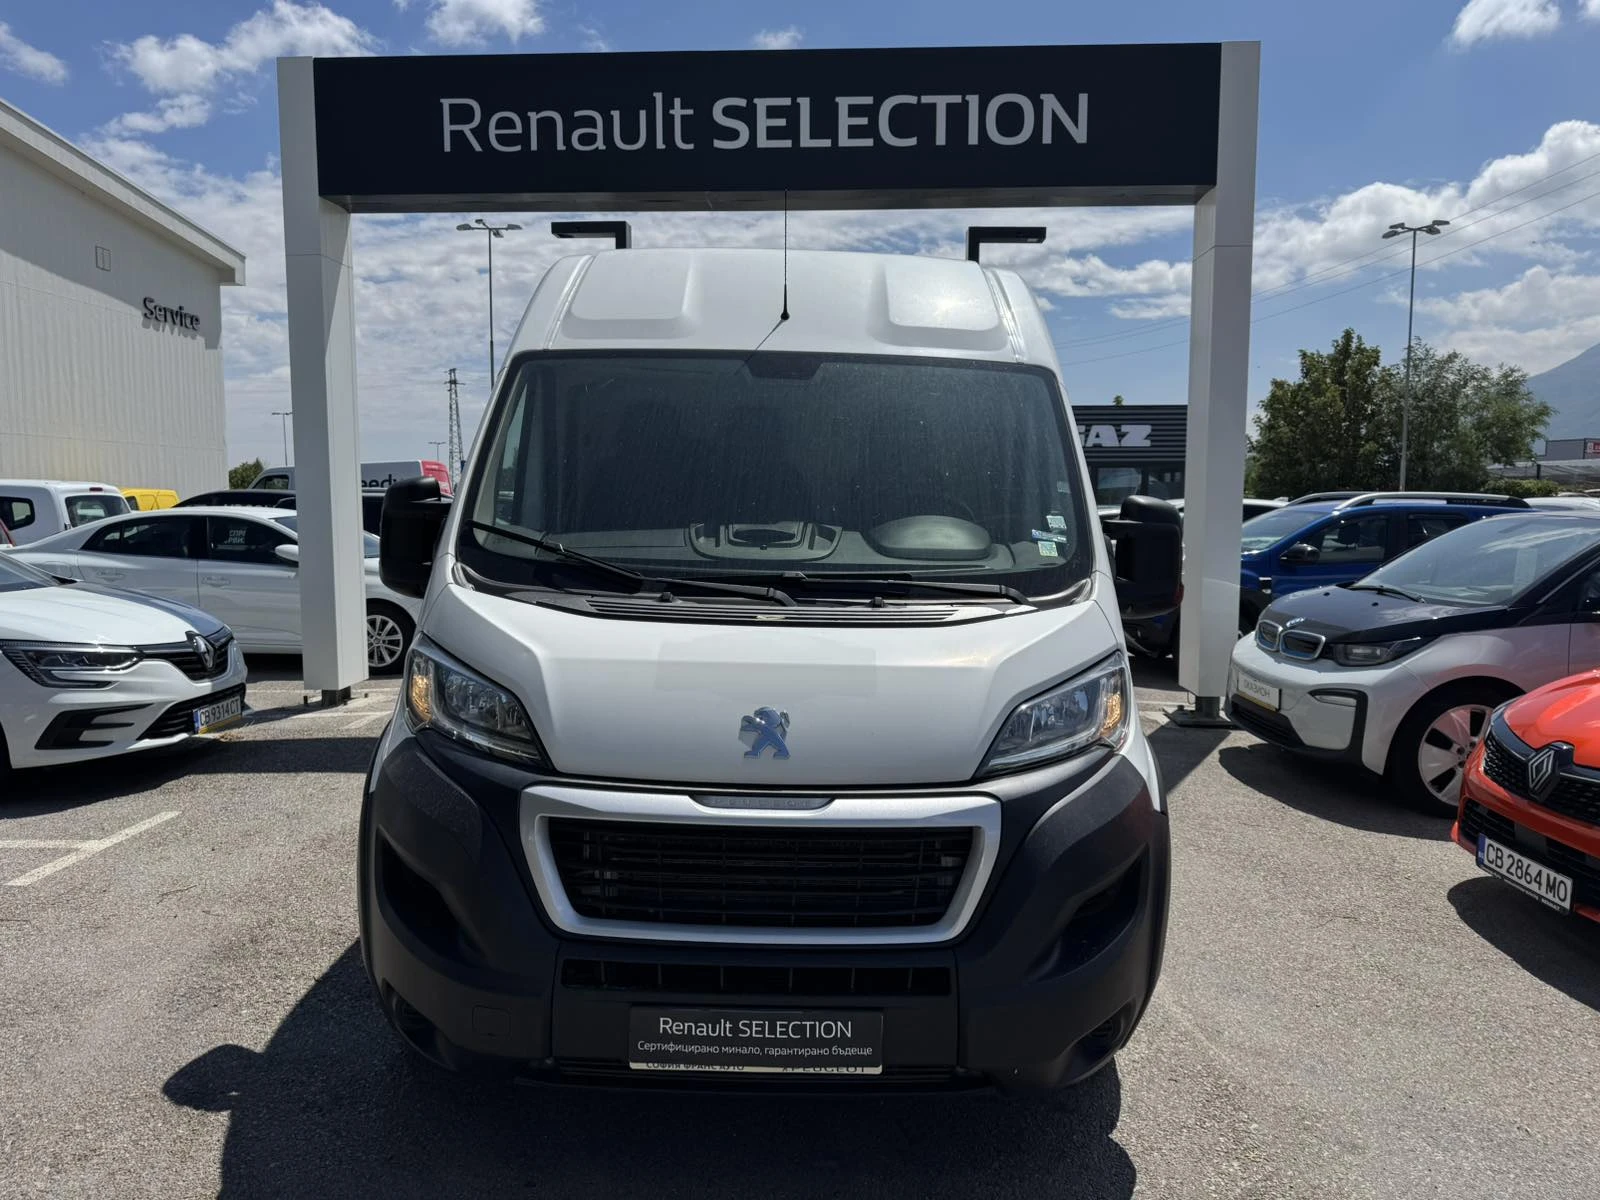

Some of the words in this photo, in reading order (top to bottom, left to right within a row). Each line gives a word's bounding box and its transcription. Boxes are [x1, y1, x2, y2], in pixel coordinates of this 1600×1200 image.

[440, 91, 695, 152] Renault
[712, 93, 1089, 150] SELECTION
[143, 296, 201, 331] Service
[1486, 843, 1504, 869] CB
[1506, 854, 1543, 891] 2864
[1545, 872, 1568, 902] MO
[659, 1017, 733, 1037] Renault
[738, 1019, 851, 1038] SELECTION
[637, 1040, 720, 1054] Сертифицирано
[721, 1045, 762, 1056] минало,
[764, 1046, 830, 1058] гарантирано
[831, 1045, 873, 1057] бъдеще
